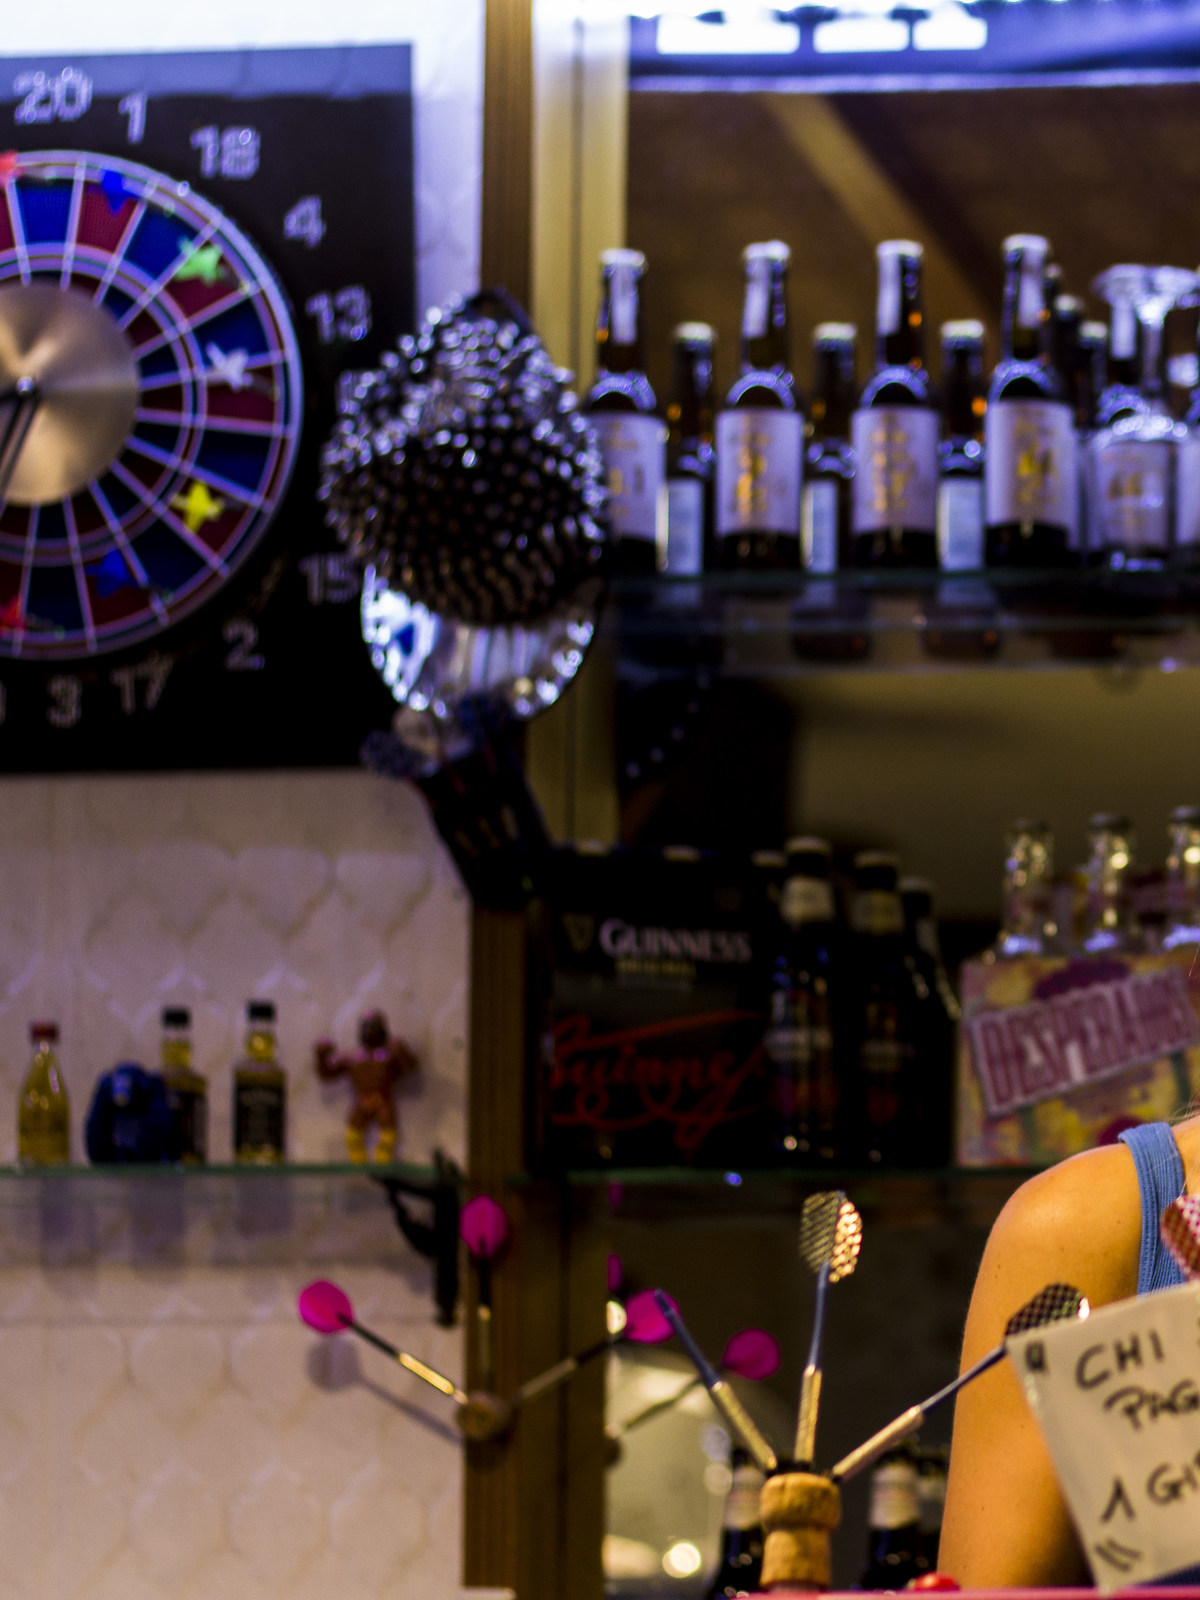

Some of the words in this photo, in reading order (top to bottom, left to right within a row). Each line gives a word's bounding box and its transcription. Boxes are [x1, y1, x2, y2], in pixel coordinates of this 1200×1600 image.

[14, 67, 93, 124] 20
[118, 92, 148, 143] 1
[190, 125, 260, 180] 18
[283, 195, 326, 248] 4
[306, 284, 371, 342] 13
[221, 620, 265, 671] 2
[46, 673, 83, 729] 3
[108, 654, 174, 716] 17
[599, 917, 752, 964] GUINNESS
[1075, 1328, 1165, 1391] CHI
